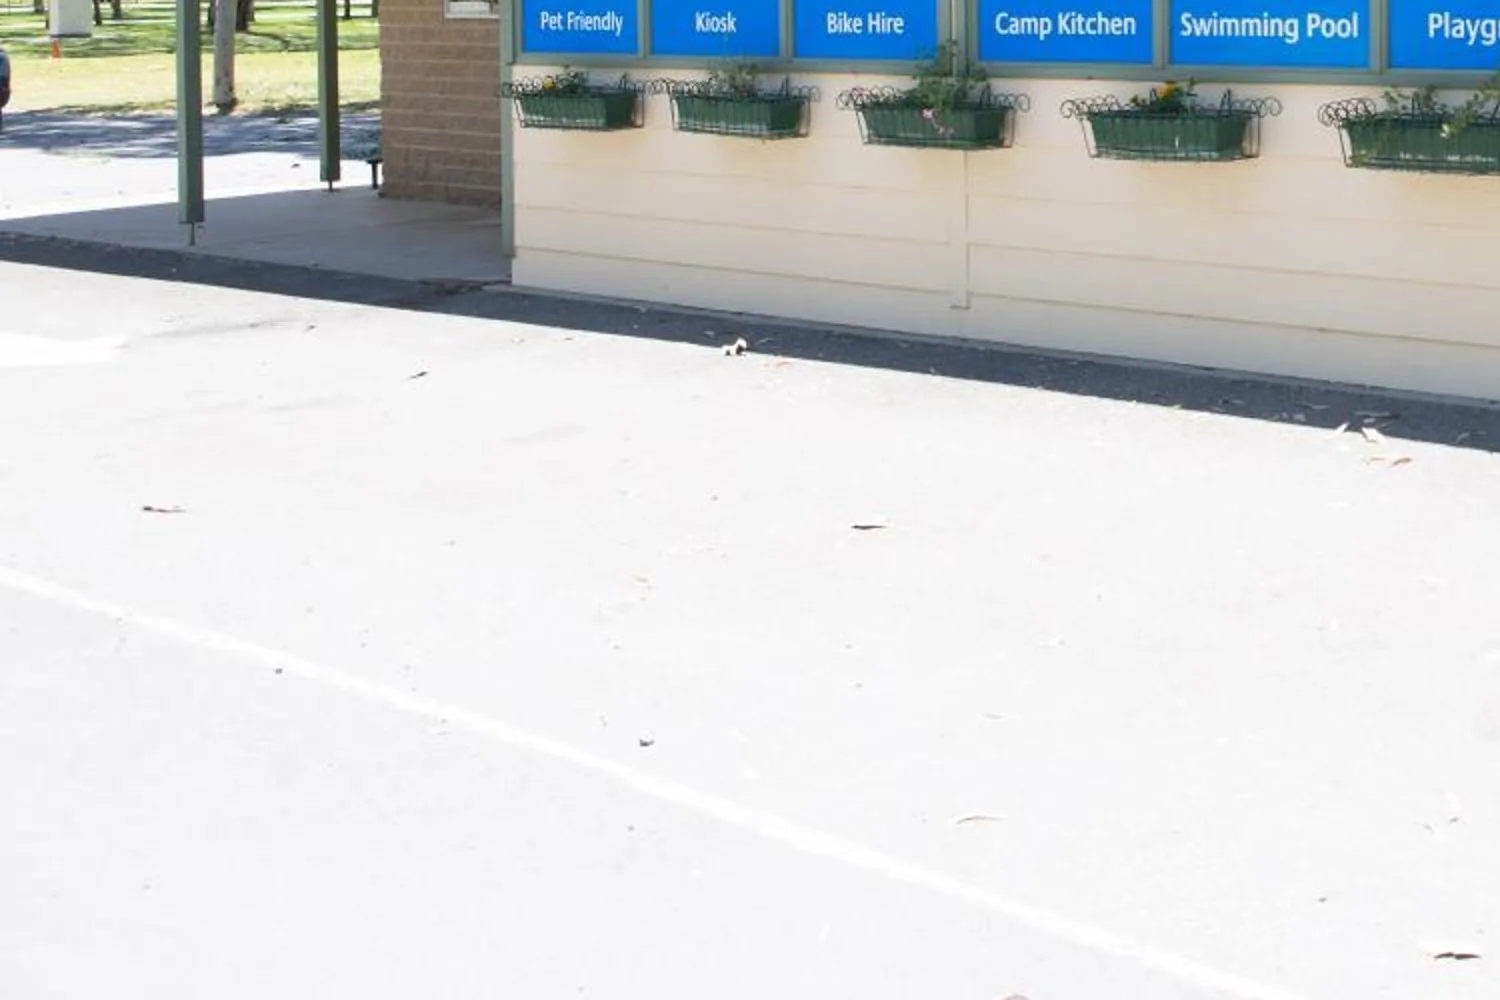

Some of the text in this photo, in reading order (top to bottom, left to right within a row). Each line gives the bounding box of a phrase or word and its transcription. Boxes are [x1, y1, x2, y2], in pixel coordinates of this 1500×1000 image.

[540, 10, 624, 37] Pet Friendly
[695, 11, 738, 34] Kiosk
[826, 11, 905, 35] Bike Hire
[994, 11, 1137, 41] Camp Kitchen
[1179, 11, 1359, 45] Swimming Pool
